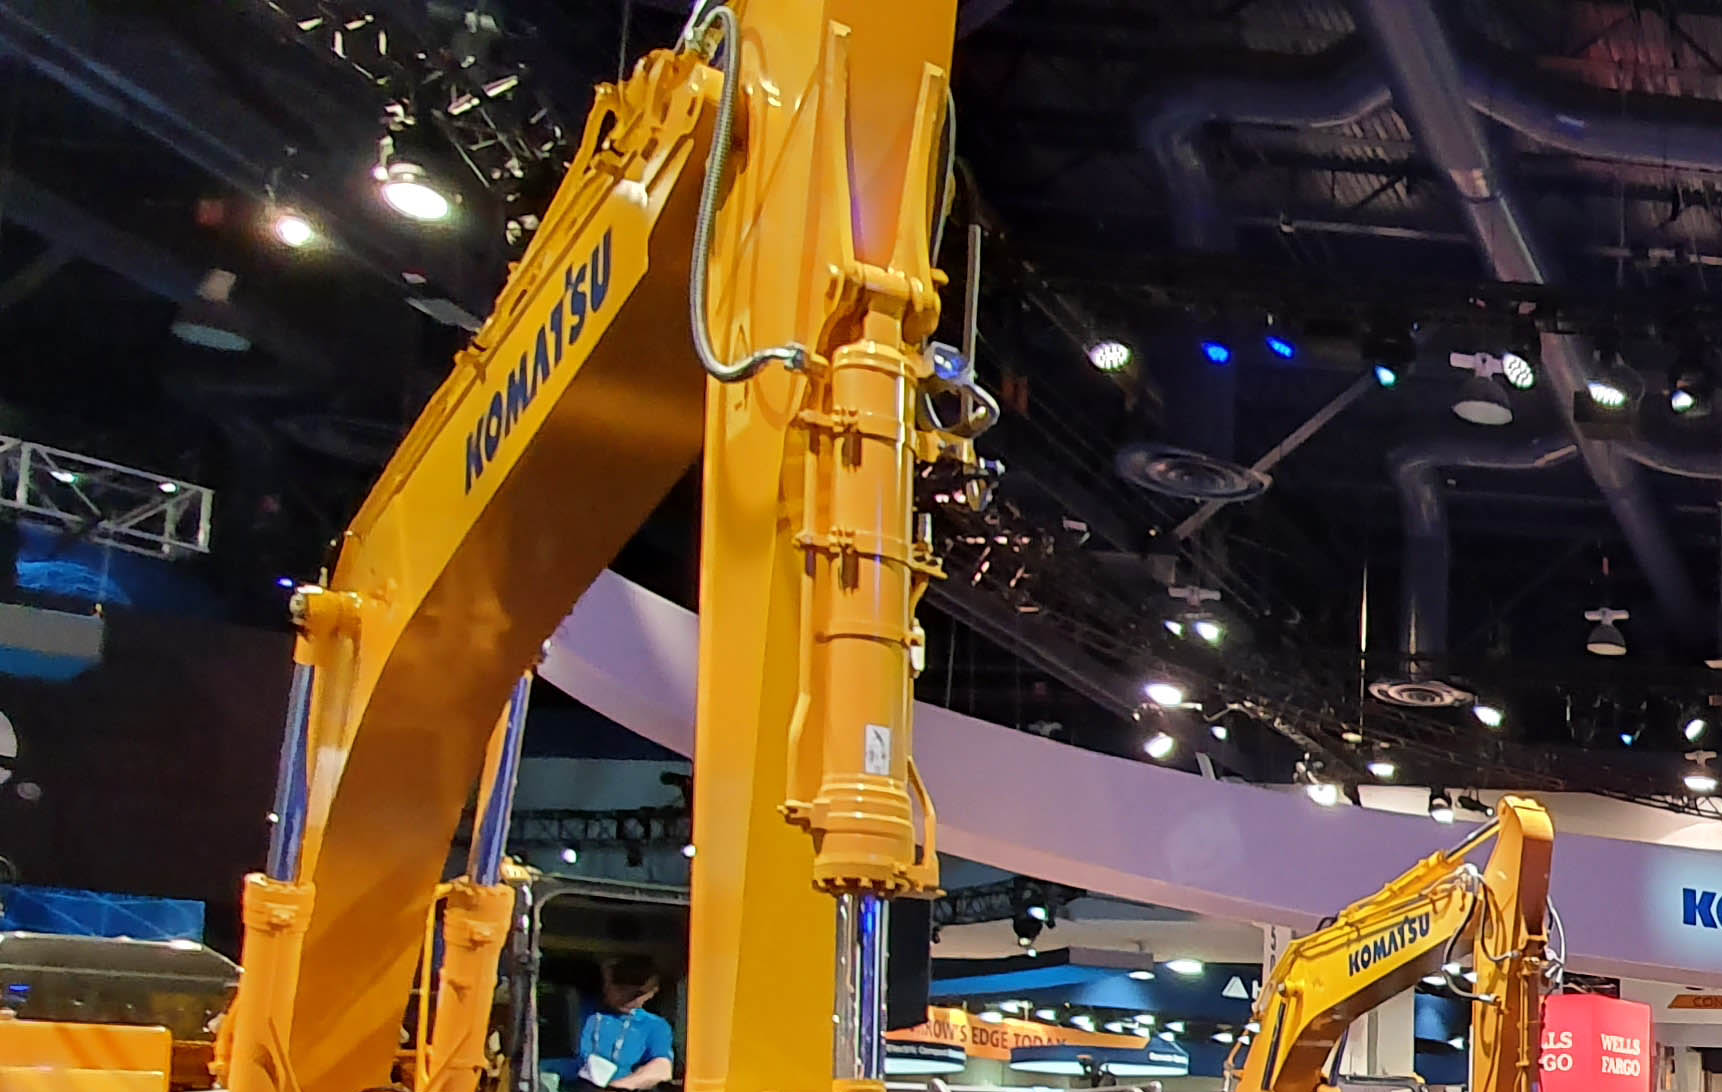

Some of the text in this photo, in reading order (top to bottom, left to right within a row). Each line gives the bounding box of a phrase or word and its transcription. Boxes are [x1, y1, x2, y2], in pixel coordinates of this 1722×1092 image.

[465, 226, 612, 495] KOMATSU
[1348, 912, 1430, 977] KOMATSU
[971, 1026, 1009, 1048] EDGE
[1600, 1033, 1641, 1056] WELLS
[1601, 1055, 1641, 1077] FARGO
